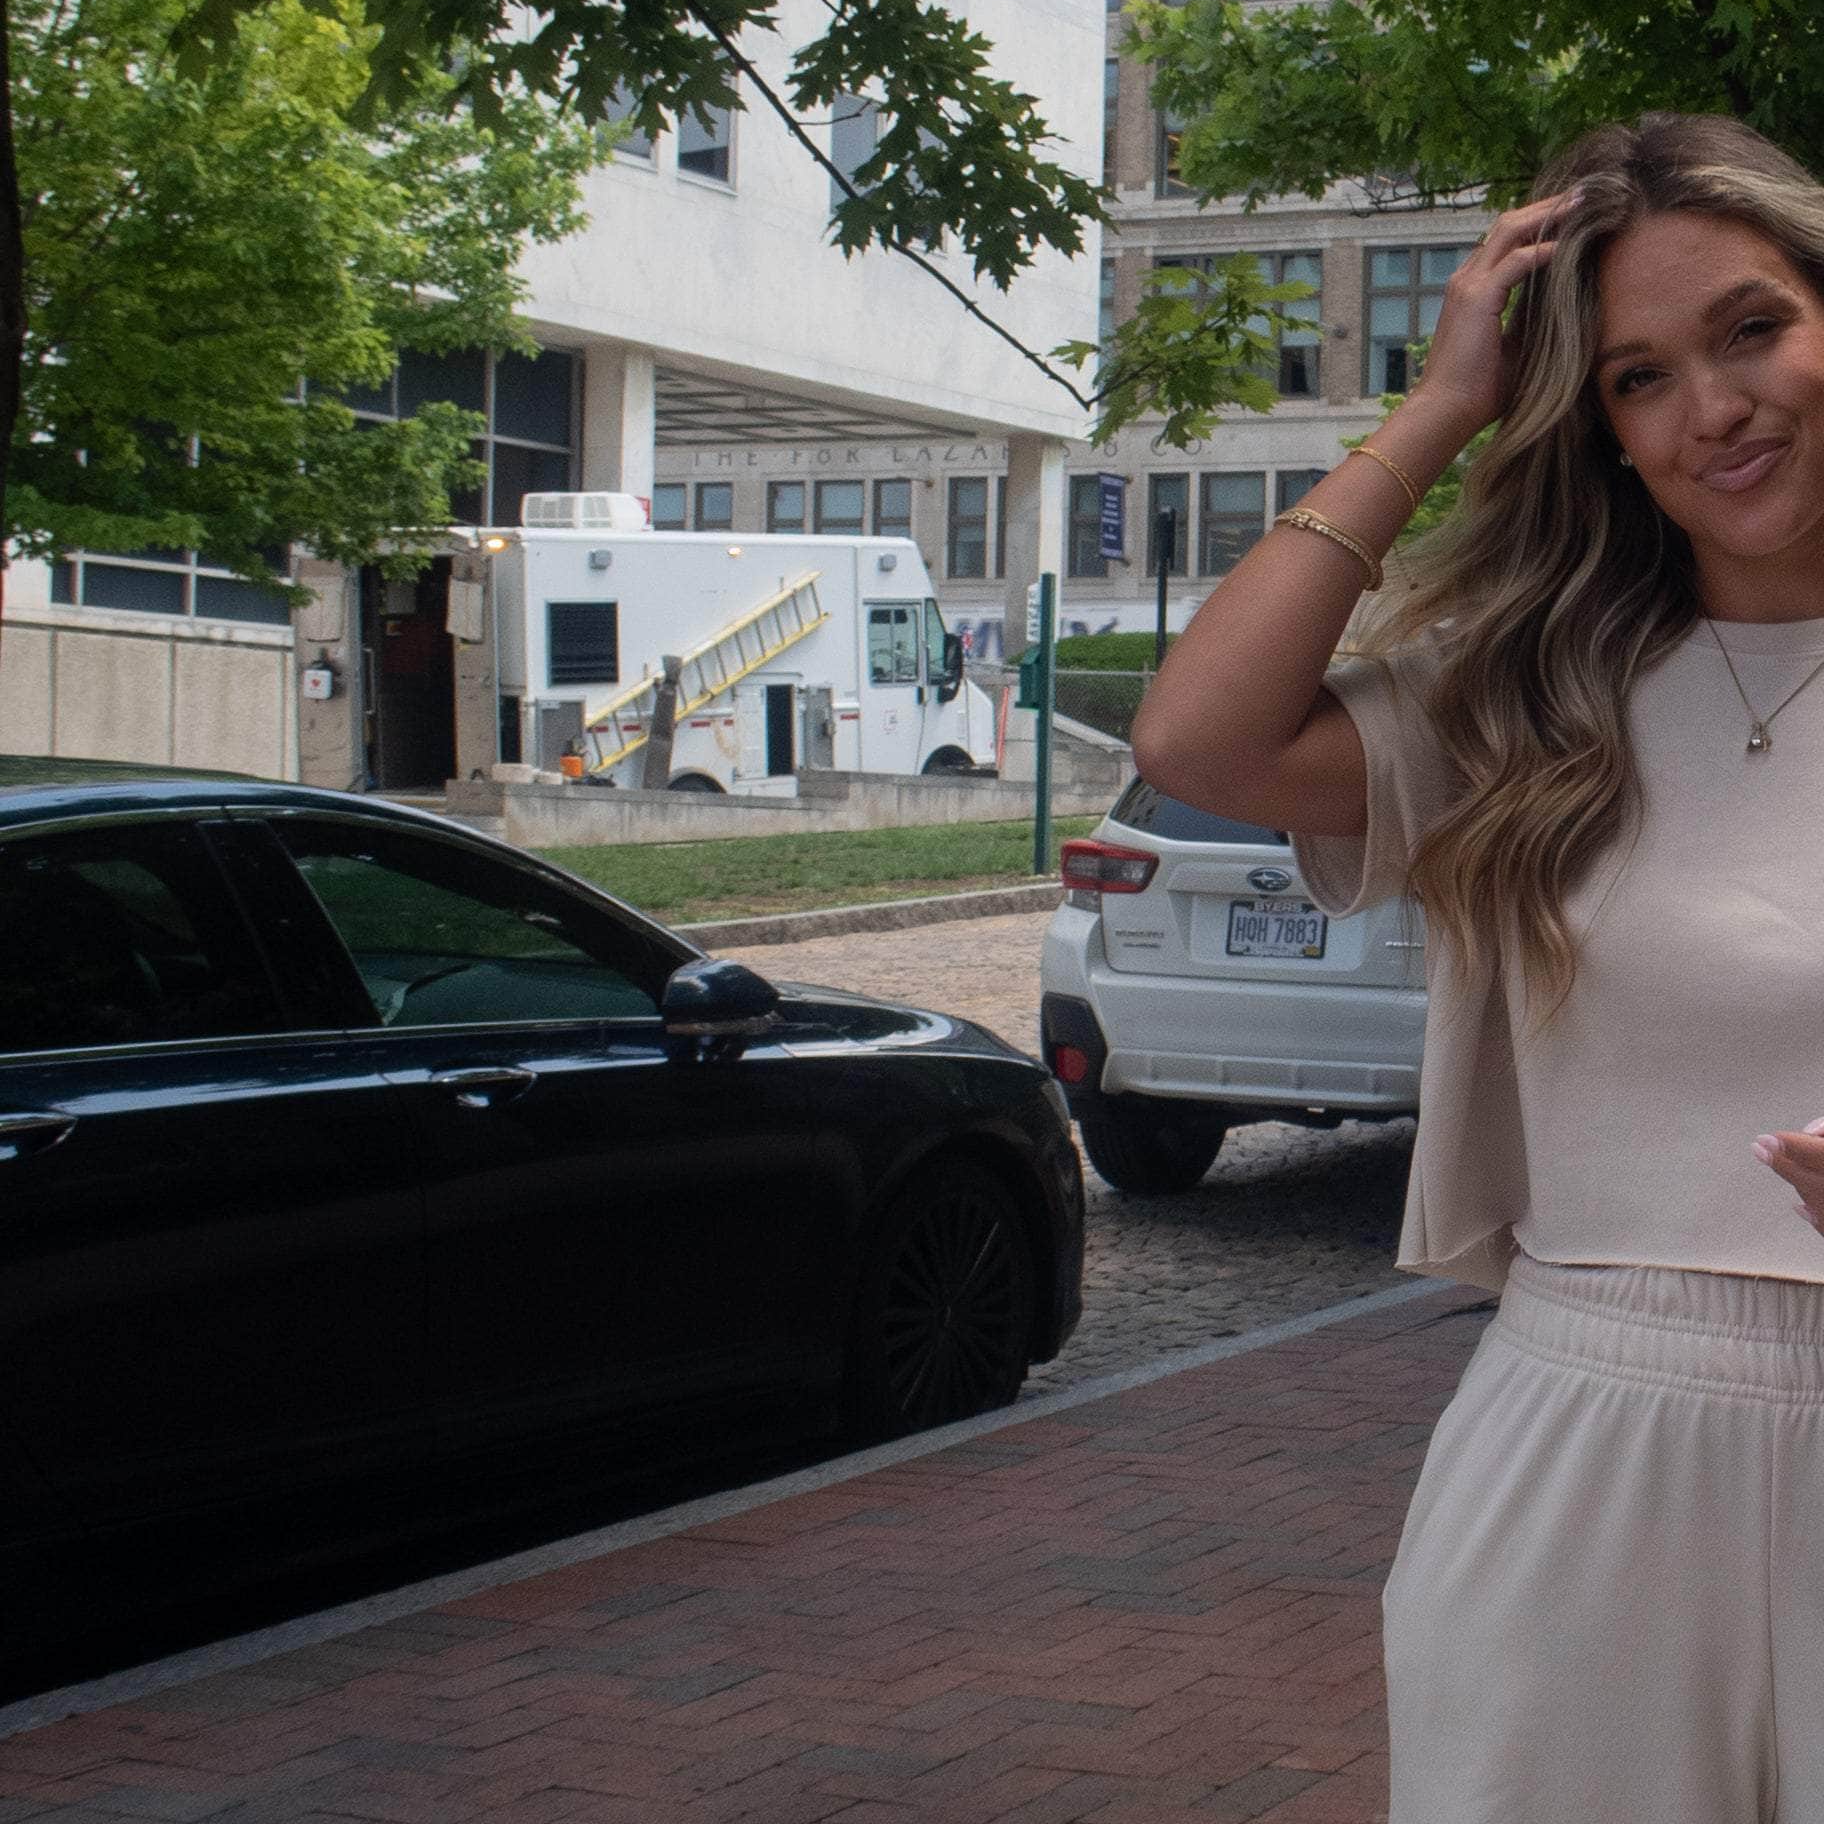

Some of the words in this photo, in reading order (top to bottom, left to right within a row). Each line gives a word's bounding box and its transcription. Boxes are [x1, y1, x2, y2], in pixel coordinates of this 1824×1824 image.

[691, 451, 758, 467] THE
[892, 442, 1071, 463] LAZAS
[1274, 918, 1318, 945] 7883
